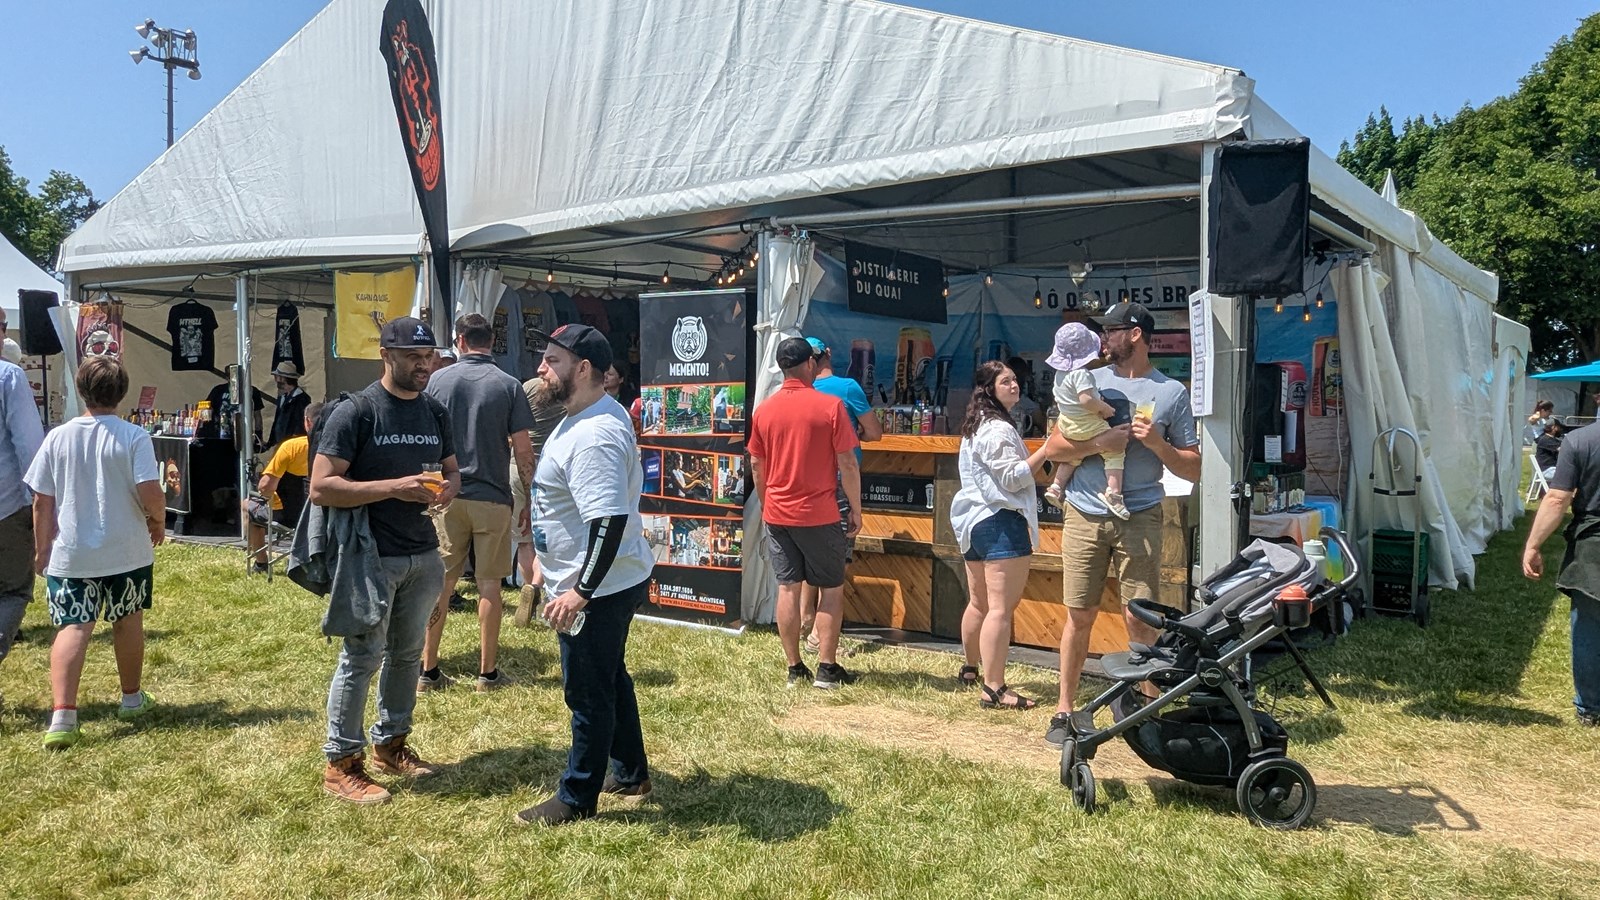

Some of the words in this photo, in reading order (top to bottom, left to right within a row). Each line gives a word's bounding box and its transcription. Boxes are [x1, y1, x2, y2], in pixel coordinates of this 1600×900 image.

[855, 260, 920, 284] DISTILERIE
[856, 280, 871, 295] DU
[875, 284, 901, 300] QUAI
[1048, 288, 1059, 309] Ô
[1066, 290, 1110, 309] QAI
[1117, 287, 1153, 304] DES
[669, 362, 710, 377] MEMENTO!
[373, 434, 440, 447] VAGABOND
[870, 494, 903, 502] BRASSEURS
